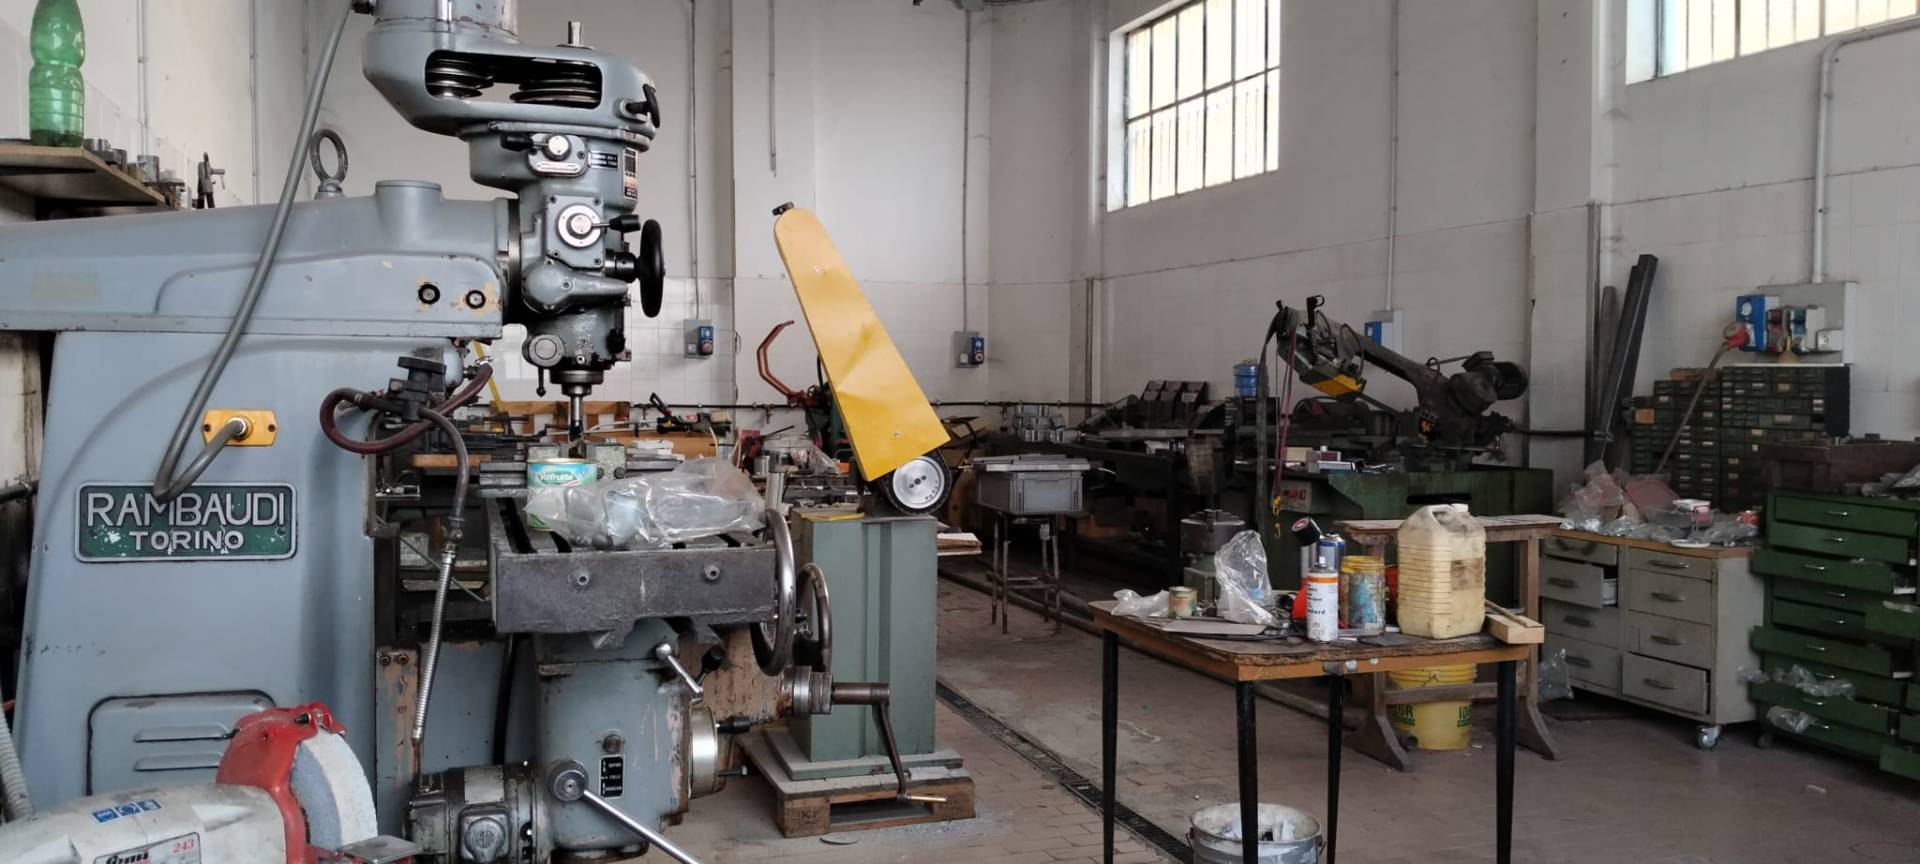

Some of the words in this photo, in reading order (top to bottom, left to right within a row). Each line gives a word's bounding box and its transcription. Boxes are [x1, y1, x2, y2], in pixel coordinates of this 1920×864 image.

[87, 492, 285, 527] RAMBAUDI
[129, 530, 244, 550] TORINO
[172, 839, 195, 854] 243
